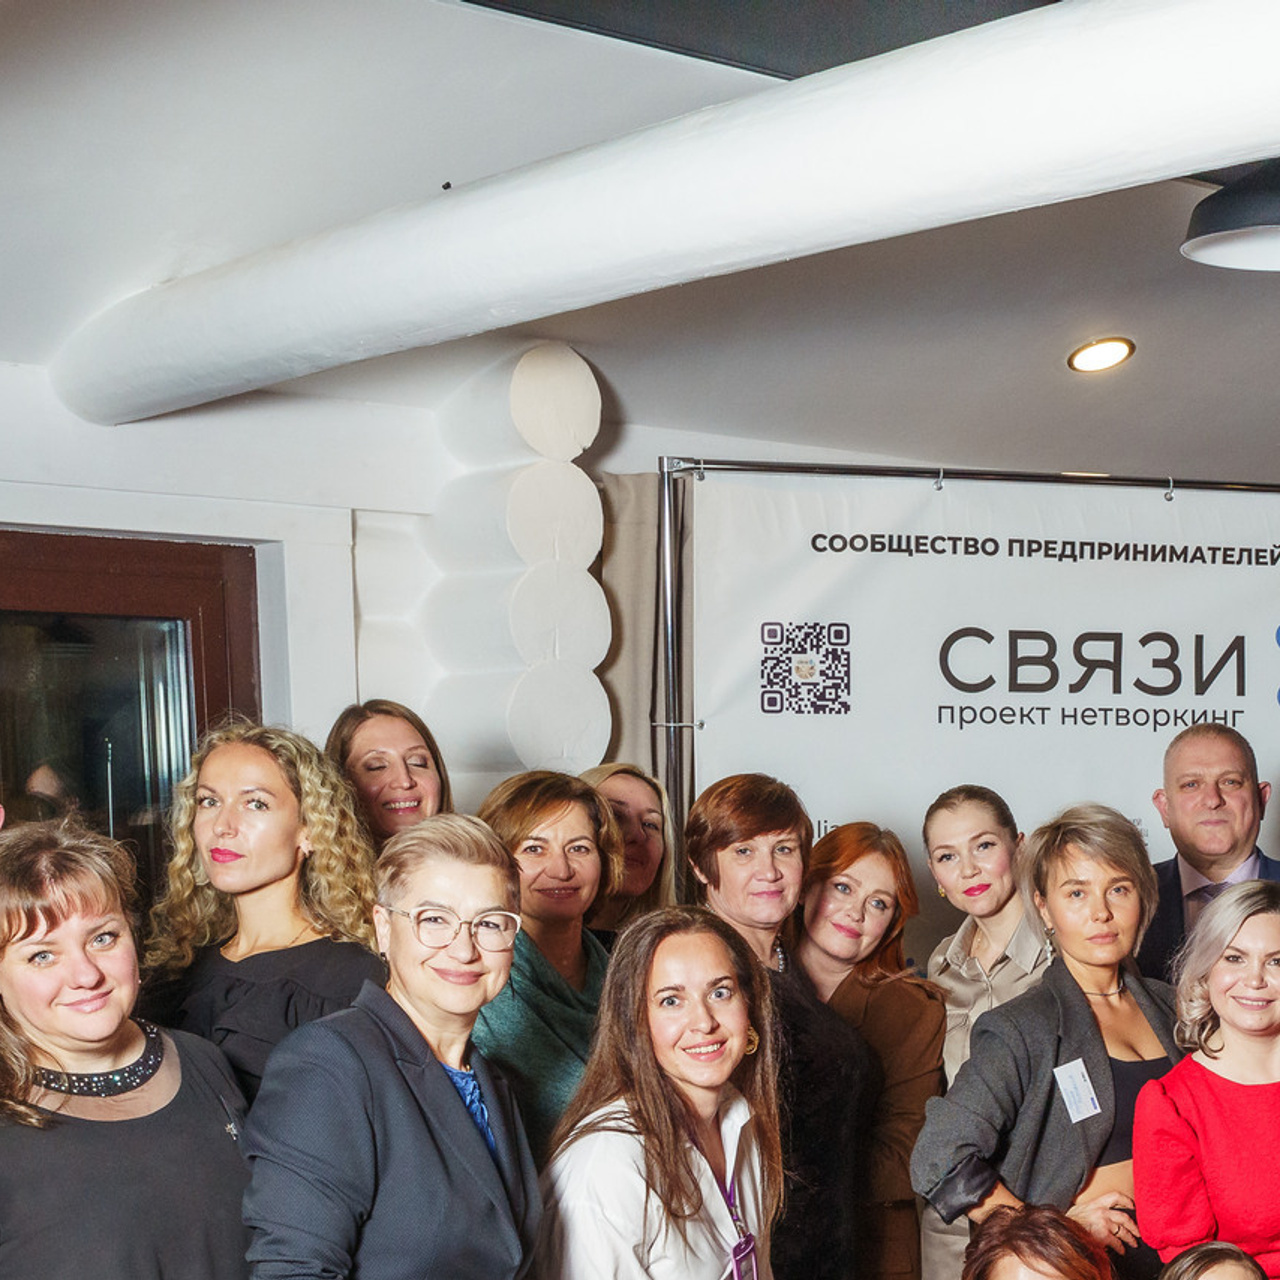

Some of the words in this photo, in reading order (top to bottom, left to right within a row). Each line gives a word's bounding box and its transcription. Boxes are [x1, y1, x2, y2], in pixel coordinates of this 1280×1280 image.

[811, 533, 1000, 557] СООБЩЕСТВО
[939, 626, 1246, 697] СВЯЗИ
[938, 705, 1051, 731] проект
[1061, 707, 1245, 733] нетворкинг
